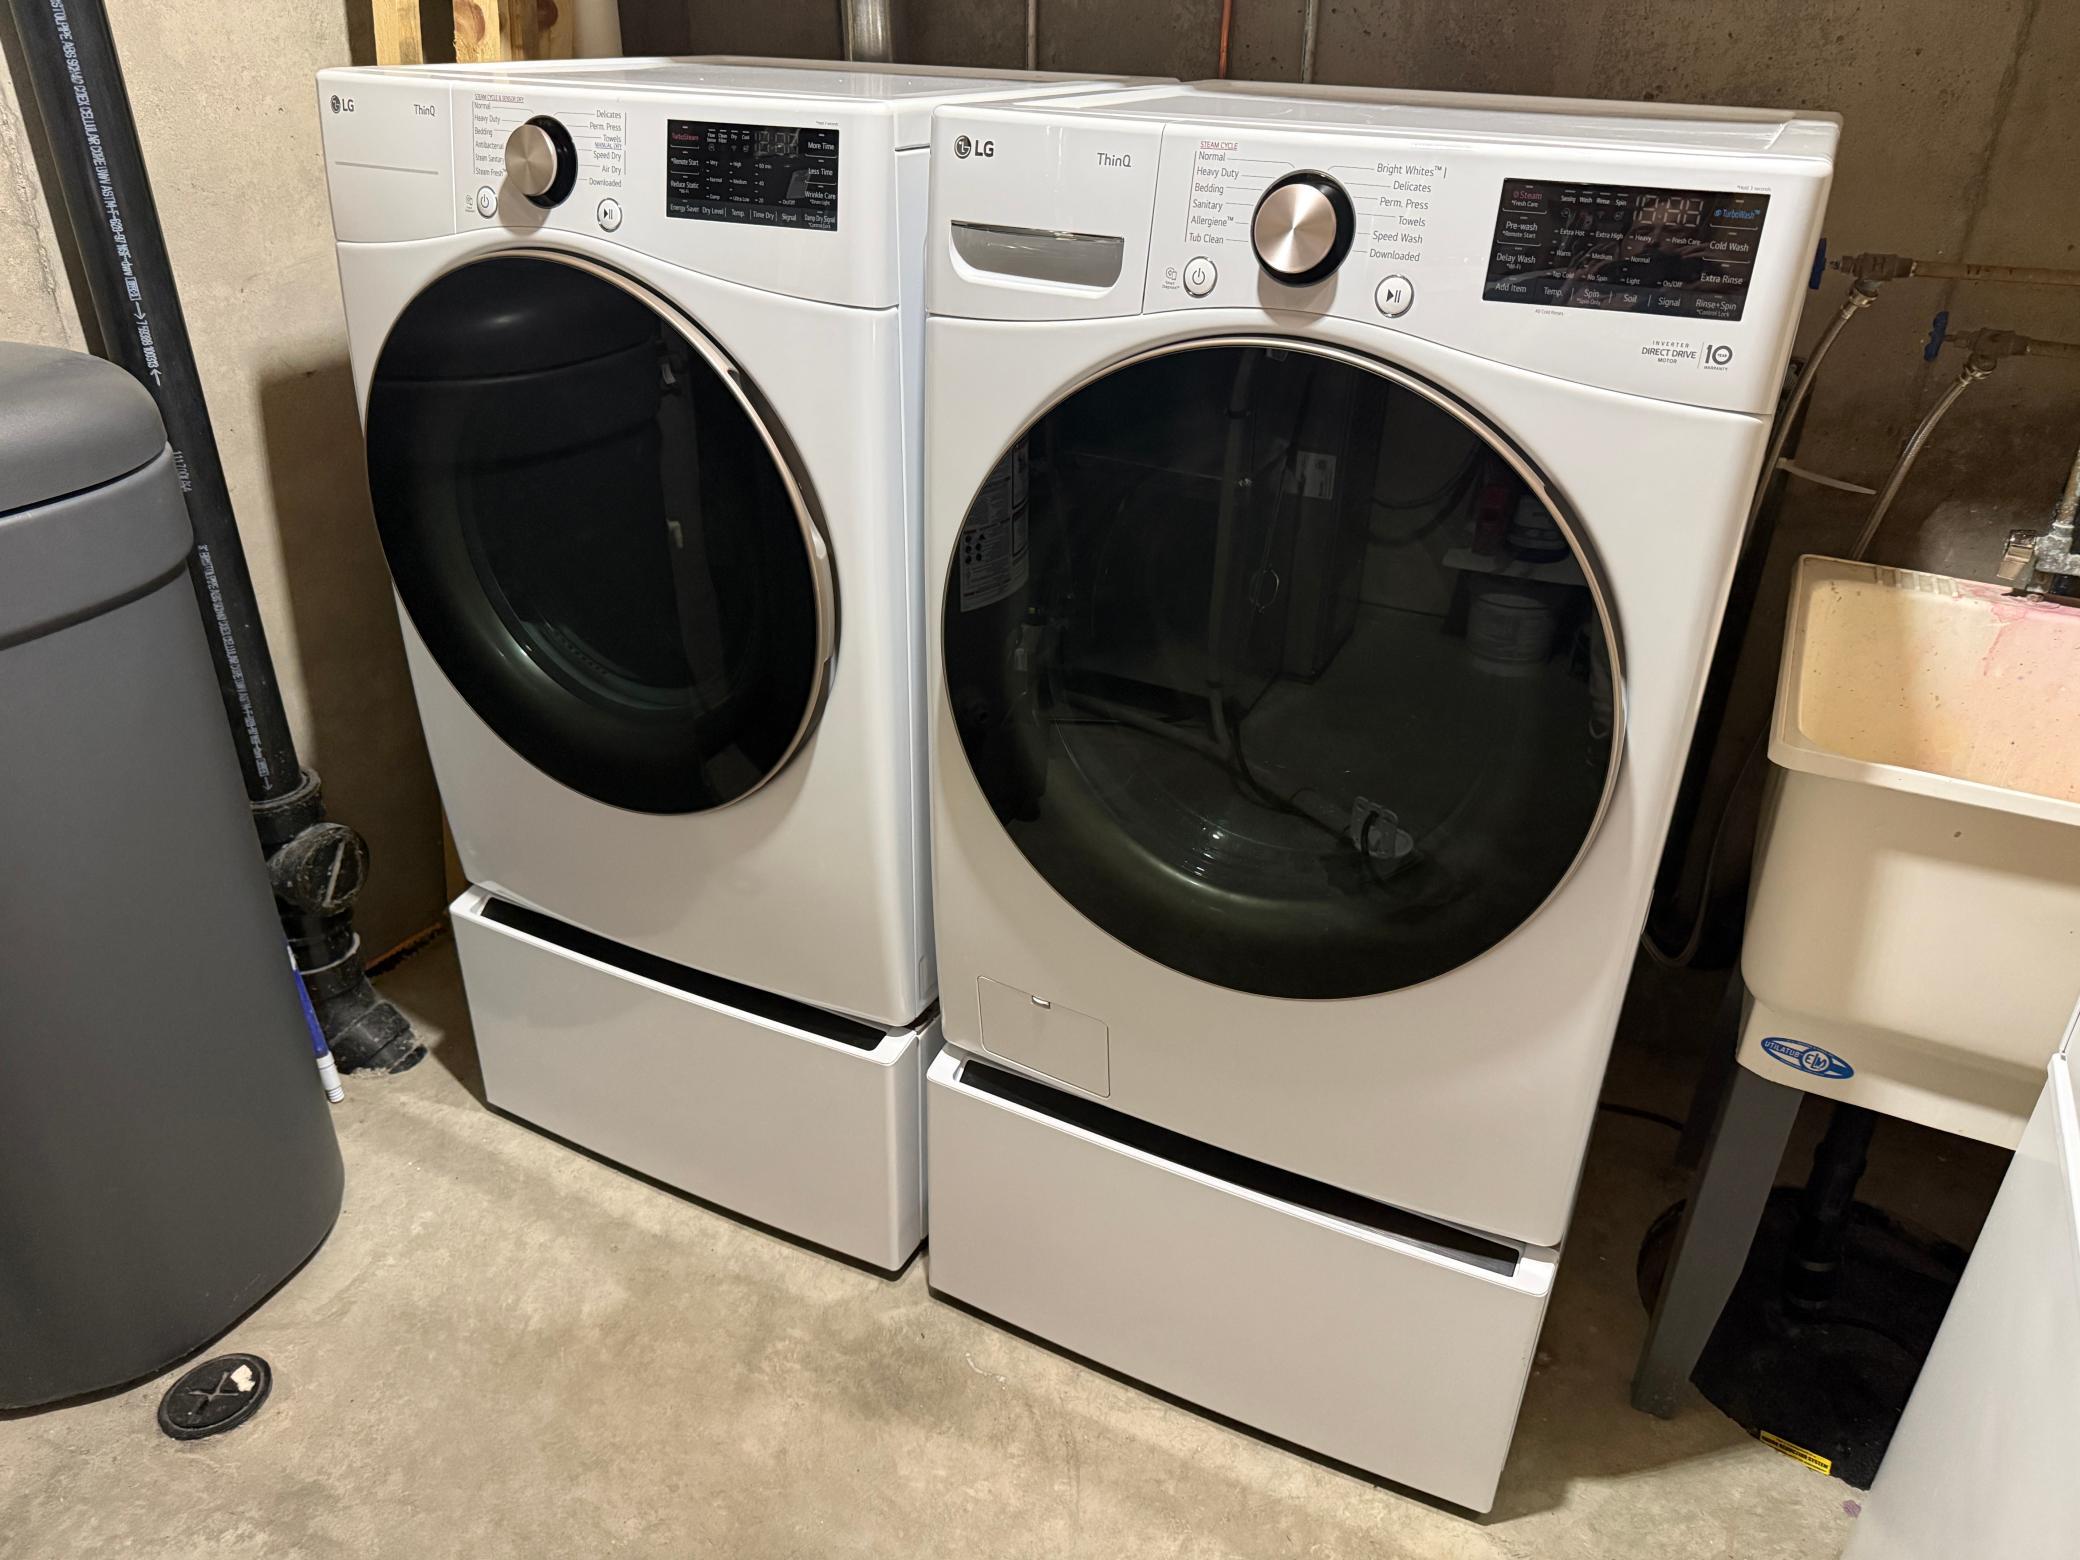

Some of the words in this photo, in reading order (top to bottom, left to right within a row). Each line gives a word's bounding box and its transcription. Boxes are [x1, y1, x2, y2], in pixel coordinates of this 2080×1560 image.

[62, 41, 77, 58] ABS
[79, 106, 101, 145] CELLULAR
[342, 98, 354, 112] LG
[413, 104, 436, 117] ThinQ
[596, 110, 622, 119] Delicates
[475, 114, 488, 124] Heavy
[489, 115, 500, 125] Duty
[475, 127, 492, 137] Bedding
[590, 122, 605, 130] Perm.
[606, 122, 622, 132] Press
[603, 134, 622, 142] Towels
[822, 142, 835, 150] Time
[974, 140, 995, 158] LG
[1200, 140, 1220, 148] STEAM
[1220, 142, 1238, 150] CYCLE
[476, 154, 488, 162] Steam
[593, 150, 610, 160] Speed
[611, 152, 622, 161] Dry
[1097, 152, 1132, 168] ThinQ
[1198, 151, 1226, 162] Normal
[688, 158, 699, 166] Start
[476, 168, 490, 176] Steam
[611, 166, 622, 175] Dry
[820, 168, 833, 176] Time
[1196, 166, 1219, 178] Heavy
[1220, 168, 1240, 180] Duty
[1376, 162, 1402, 176] Bright
[1405, 165, 1442, 177] Whites™
[588, 178, 622, 188] Downloaded
[670, 180, 686, 188] Reduce
[686, 181, 700, 189] Static
[1393, 180, 1432, 193] Delicates
[1194, 182, 1224, 196] Bedding
[804, 190, 824, 198] Wrinkle
[824, 192, 836, 200] Care
[1520, 191, 1542, 200] Steam
[670, 204, 686, 212] Energy
[686, 204, 700, 212] Saver
[1192, 198, 1223, 212] Sanitary
[1380, 196, 1403, 208] Perm.
[1406, 198, 1430, 210] Press
[1526, 200, 1539, 208] Care
[702, 206, 710, 216] Dry
[753, 210, 764, 218] Time
[766, 212, 775, 220] Dry
[782, 213, 796, 222] Signal
[1190, 215, 1234, 228] Allergiene™
[1398, 216, 1426, 227] Towels
[1506, 220, 1538, 231] Pre-wash
[1372, 230, 1398, 243] Speed
[1400, 233, 1423, 244] Wash
[1560, 228, 1574, 236] Extra
[1610, 232, 1624, 240] High
[1189, 232, 1202, 242] Tub
[1204, 234, 1224, 244] Clean
[1634, 235, 1652, 243] Heavy
[1688, 238, 1700, 246] Care
[1710, 240, 1727, 250] Cold
[1728, 242, 1749, 252] Wash
[1370, 248, 1420, 262] Downloaded
[1496, 252, 1516, 264] Delay
[1517, 254, 1536, 264] Wash
[1630, 256, 1651, 264] Normal
[1596, 274, 1608, 282] Spin
[1626, 277, 1640, 286] Light
[1700, 273, 1721, 283] Extra
[1722, 274, 1743, 284] Rinse
[1495, 282, 1509, 291] Add
[1510, 284, 1527, 293] Item
[1662, 280, 1683, 288] On/Off
[1544, 286, 1564, 298] Temp.
[1584, 288, 1600, 298] Spin
[1624, 294, 1638, 303] Soil
[1658, 297, 1680, 308] Signal
[1696, 298, 1736, 312] Rinse+Spin
[1719, 310, 1730, 318] Lock
[1652, 340, 1690, 348] INVERTER
[1642, 346, 1671, 356] DIRECT
[1672, 349, 1697, 359] DRIVE
[1705, 344, 1732, 366] 10
[1764, 1040, 1800, 1058] UTILATUB
